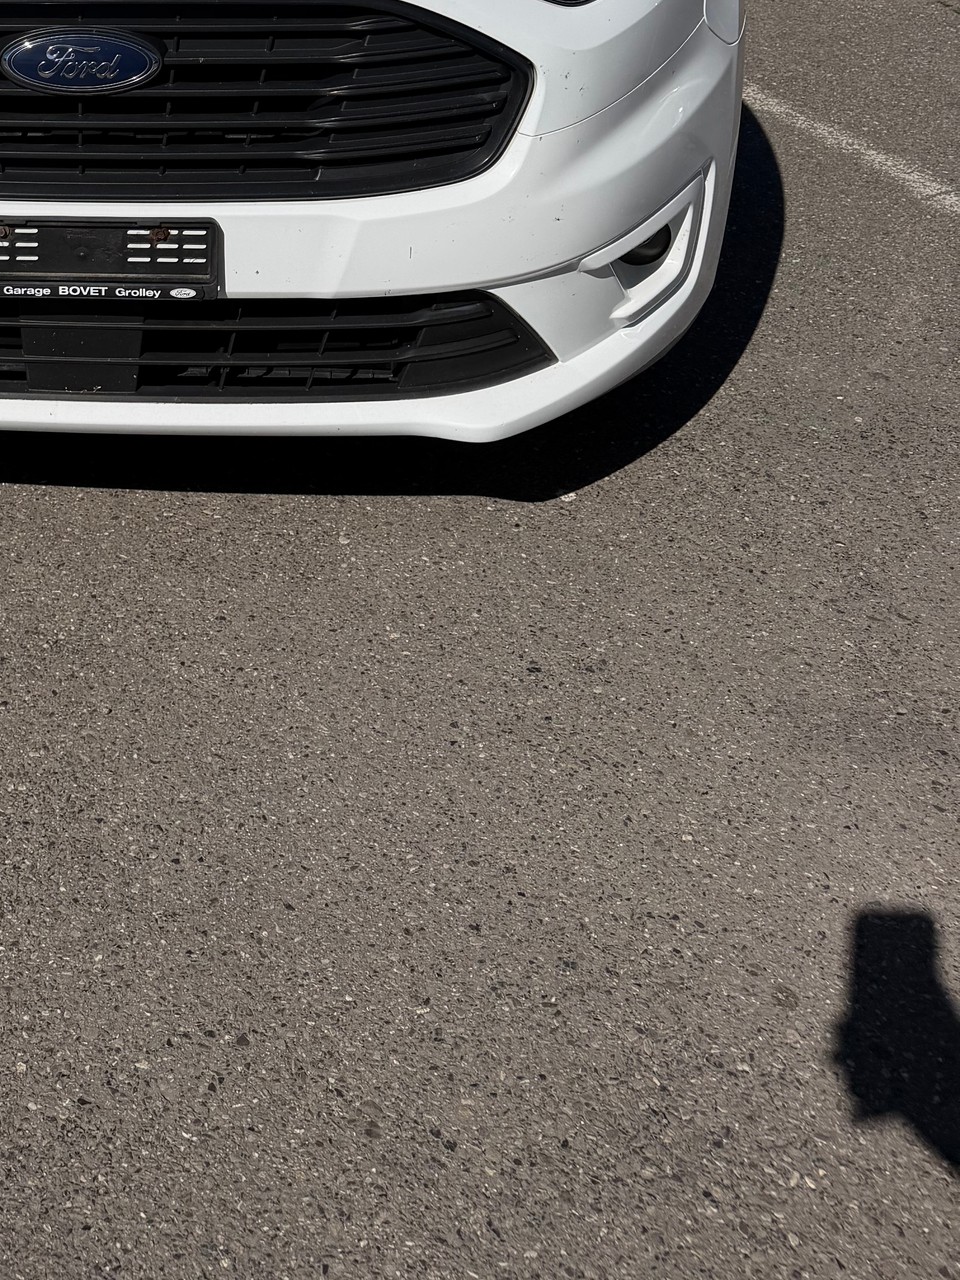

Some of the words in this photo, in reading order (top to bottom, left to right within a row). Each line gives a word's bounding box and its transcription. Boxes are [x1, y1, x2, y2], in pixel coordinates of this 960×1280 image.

[37, 44, 122, 80] Ford
[3, 286, 51, 297] Garage
[58, 285, 108, 296] BOVET
[115, 288, 161, 299] Grolley
